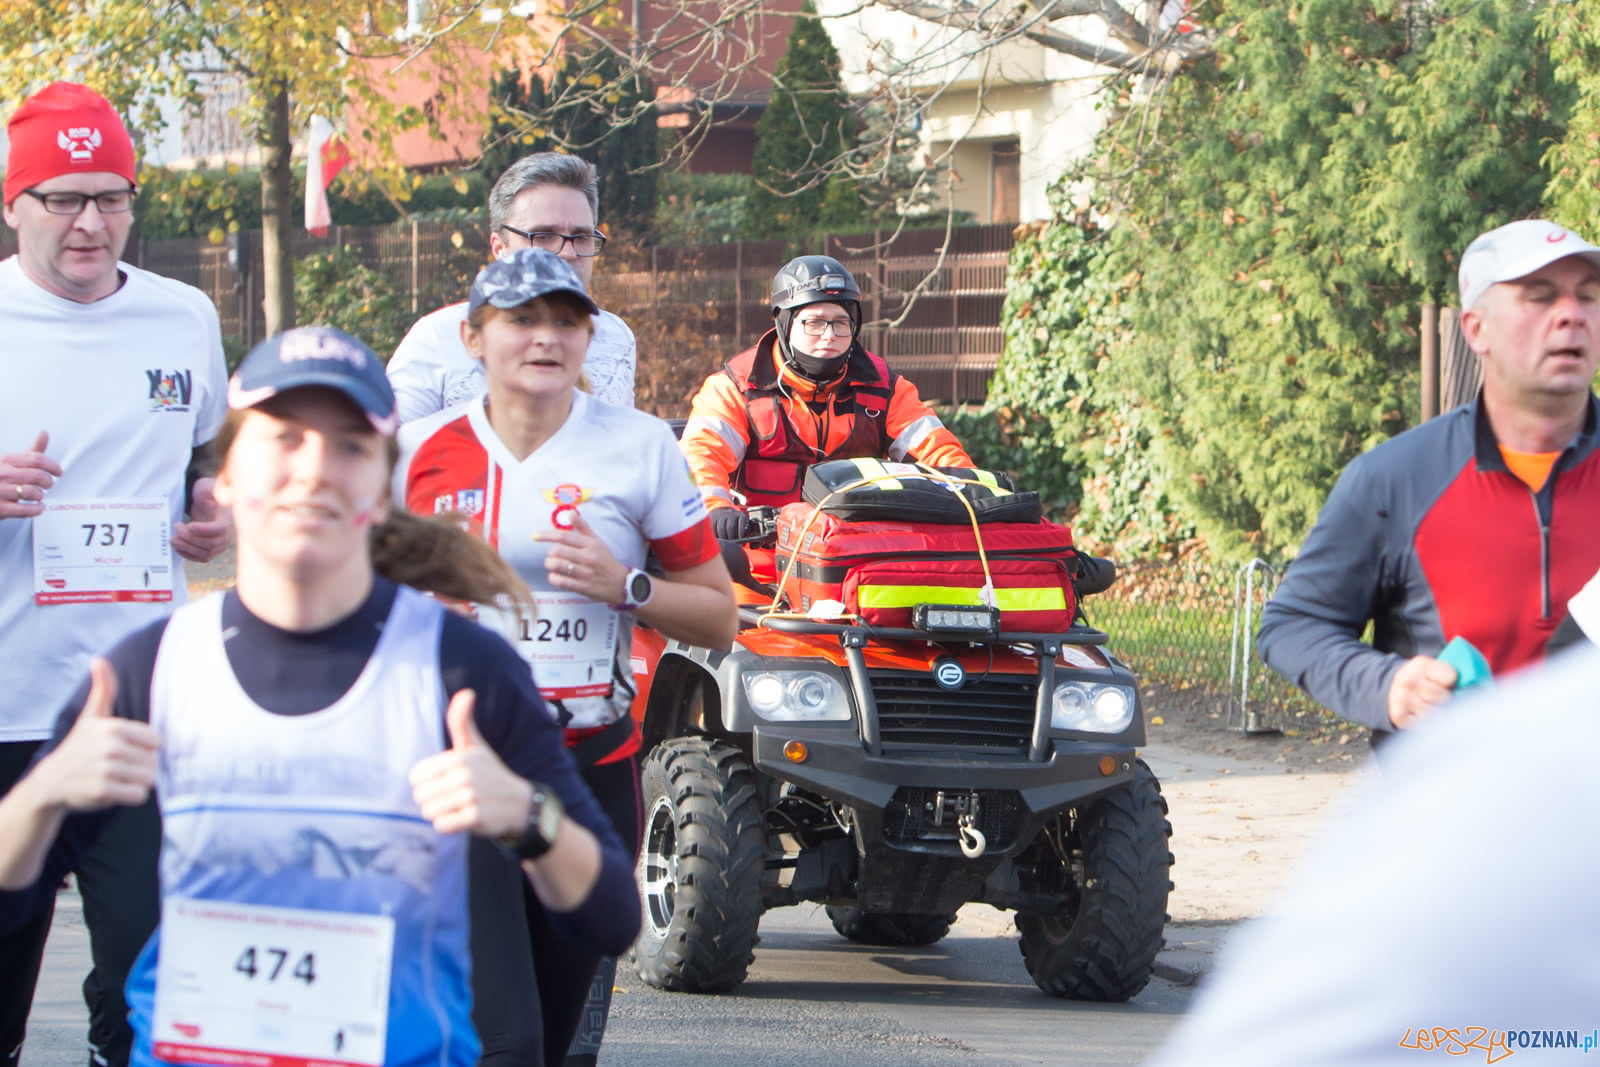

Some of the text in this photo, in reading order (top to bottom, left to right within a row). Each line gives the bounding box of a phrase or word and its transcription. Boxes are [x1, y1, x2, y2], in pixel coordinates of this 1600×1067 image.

[81, 523, 130, 546] 737
[519, 618, 588, 642] 1240
[234, 946, 316, 986] 474
